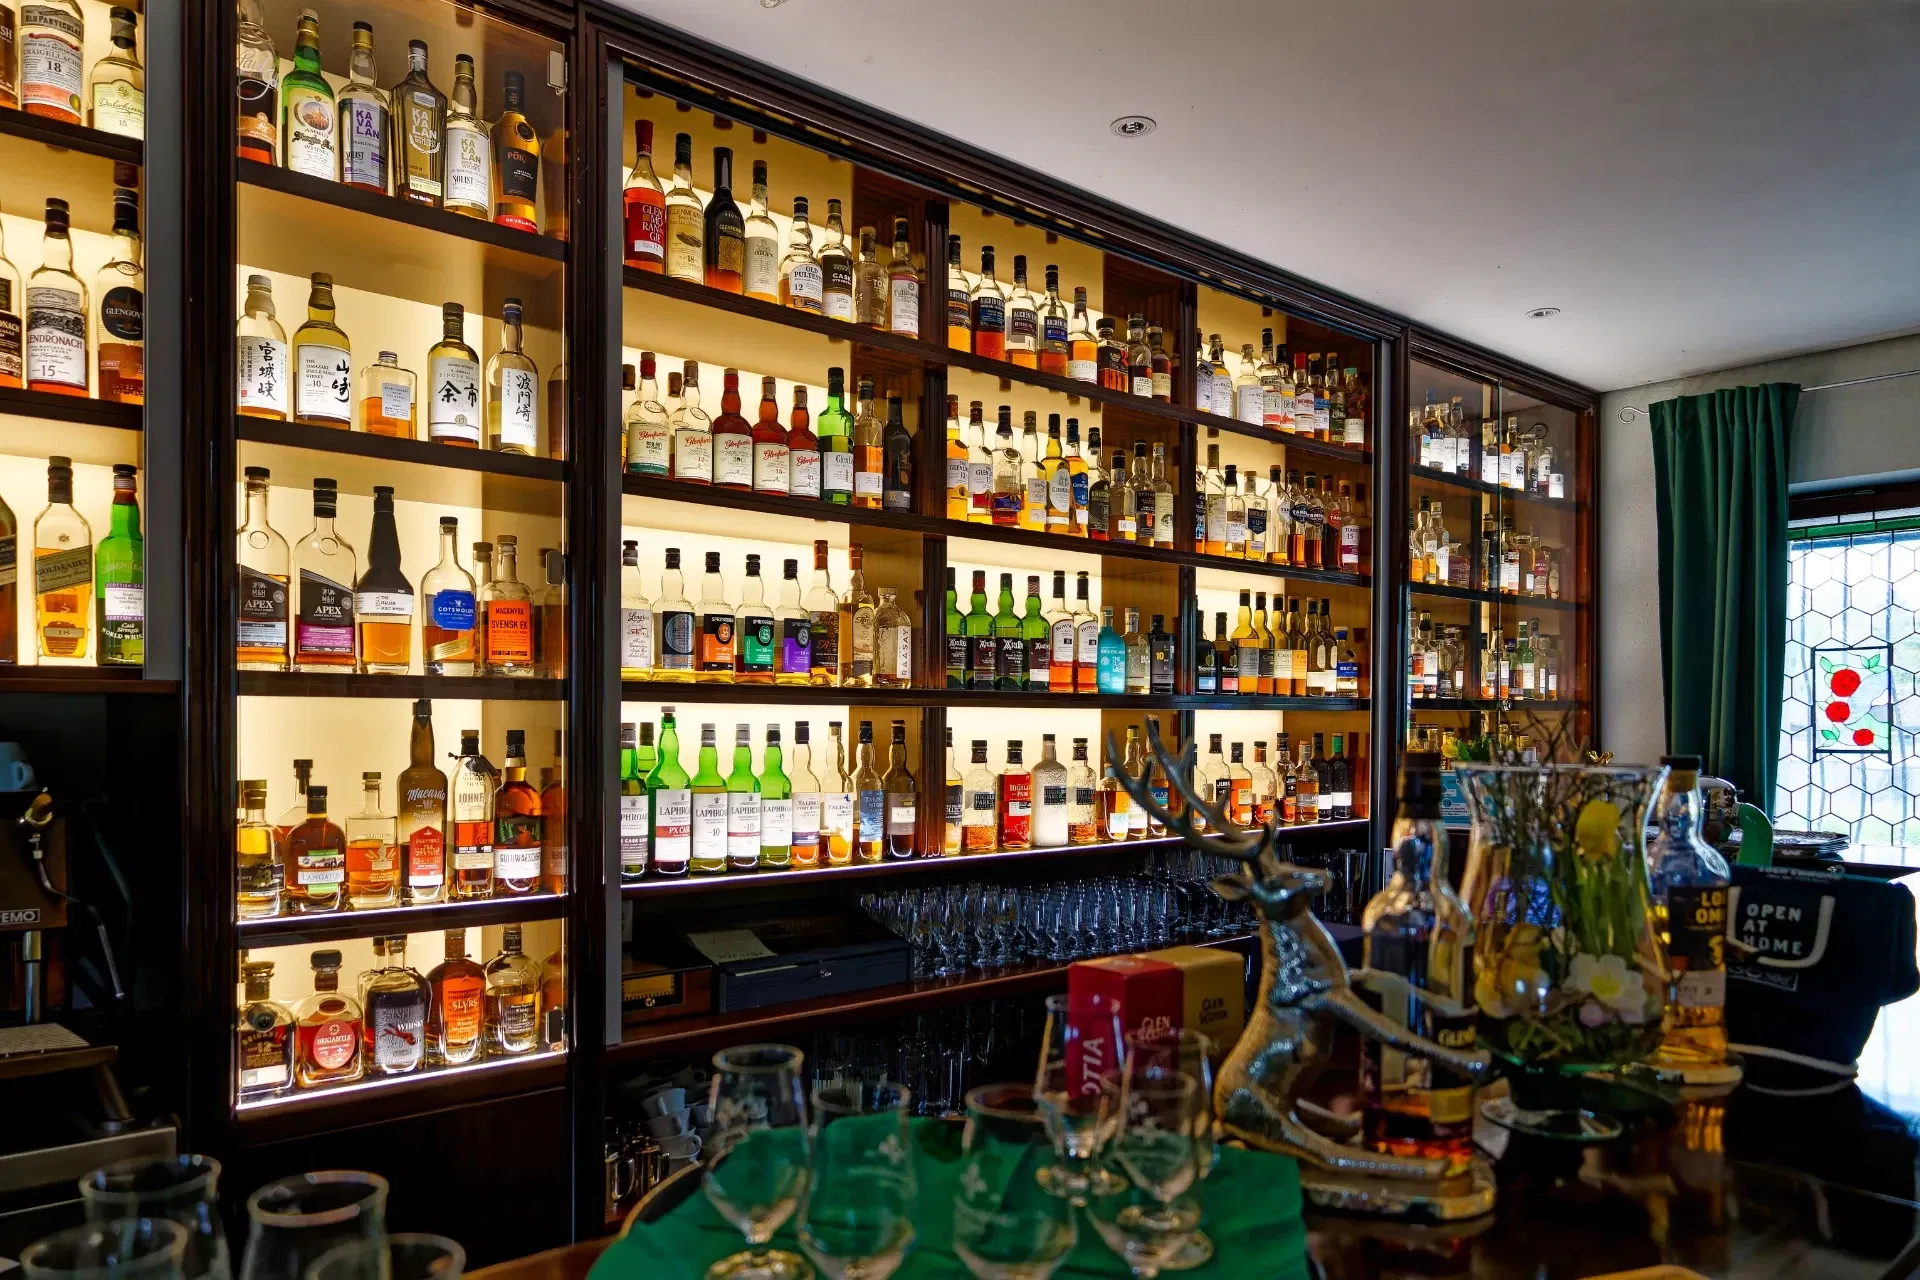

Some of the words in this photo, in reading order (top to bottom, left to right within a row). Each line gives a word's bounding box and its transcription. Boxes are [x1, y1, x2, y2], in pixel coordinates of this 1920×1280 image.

[47, 60, 62, 72] 18
[356, 110, 372, 121] KA
[412, 108, 429, 121] KA
[357, 119, 372, 129] VA
[413, 118, 429, 130] VA
[356, 126, 379, 139] LAN
[412, 127, 437, 141] LAN
[461, 138, 475, 147] KA
[461, 145, 475, 155] VA
[461, 152, 481, 164] LAN
[642, 204, 664, 219] GLEN
[651, 214, 664, 227] MO
[805, 265, 819, 274] OLD
[794, 283, 804, 291] 12
[40, 365, 56, 377] 15
[244, 600, 274, 609] APEX
[314, 606, 342, 615] APEX
[438, 606, 474, 614] COTSWOLDS
[495, 607, 524, 615] MACKMYRA
[491, 619, 518, 629] SVENSK
[519, 620, 528, 630] EK
[901, 628, 910, 676] RAASAY
[1155, 651, 1165, 660] 10
[1747, 903, 1802, 922] OPEN
[1743, 919, 1768, 933] AT
[1743, 935, 1802, 956] HOME
[452, 997, 478, 1013] SLYRS
[397, 1019, 424, 1031] WHISKY
[317, 1034, 352, 1045] BRIGANTIA
